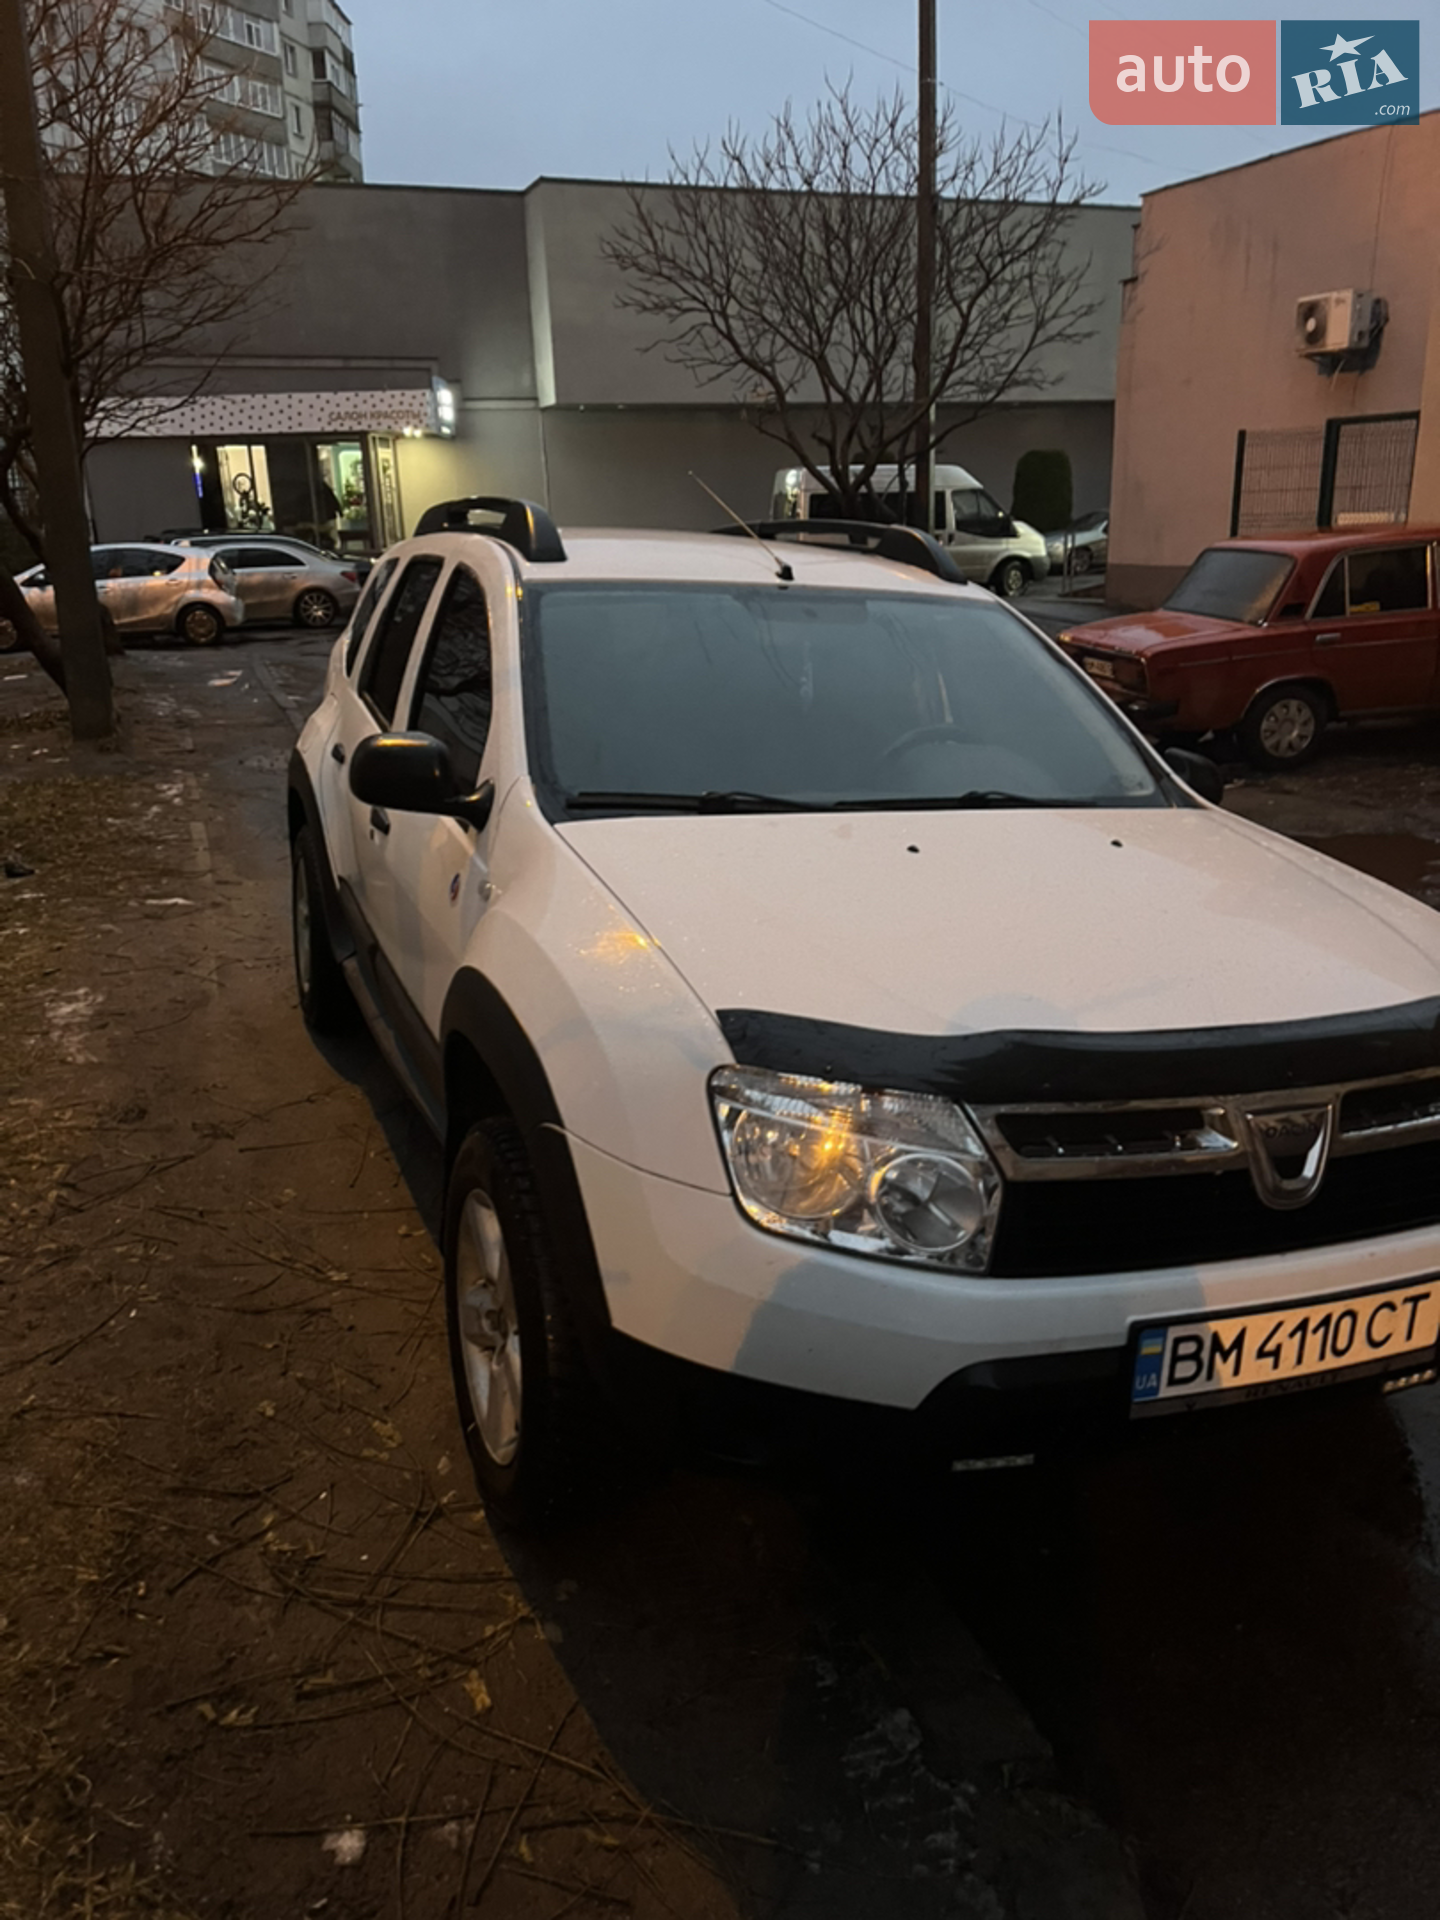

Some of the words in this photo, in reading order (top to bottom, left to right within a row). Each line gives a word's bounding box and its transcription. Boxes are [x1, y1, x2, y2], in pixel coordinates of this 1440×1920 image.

[328, 410, 367, 422] САЛОН
[369, 408, 421, 421] КРАСОТЫ
[1166, 1326, 1247, 1388] BM
[1255, 1308, 1358, 1371] 4110
[1365, 1291, 1432, 1349] CT
[1134, 1371, 1158, 1390] UA
